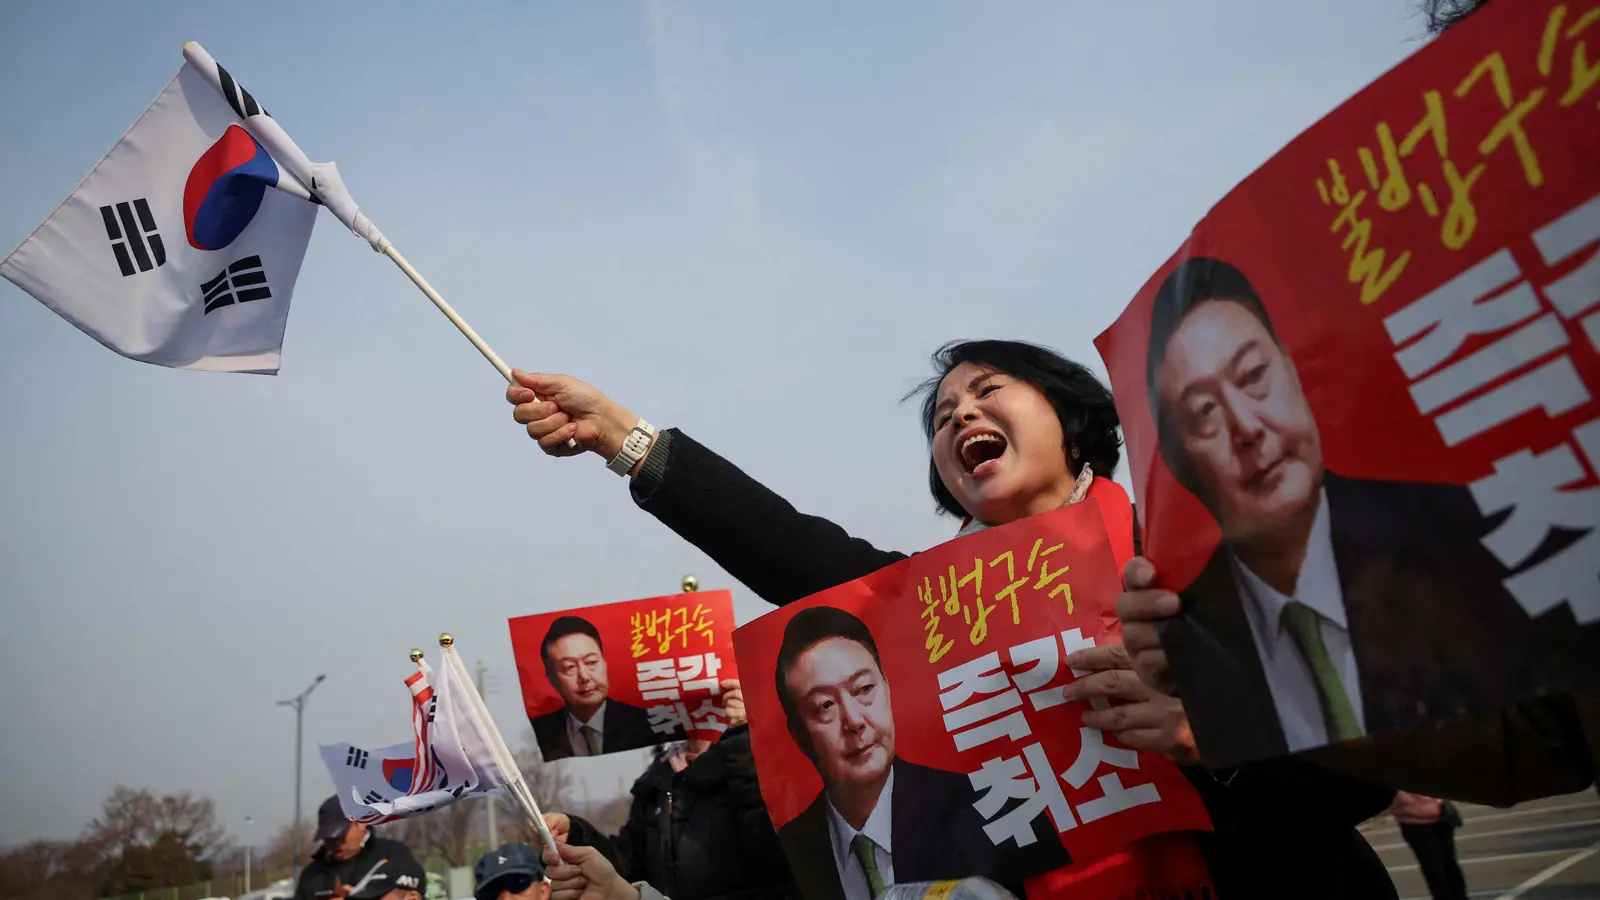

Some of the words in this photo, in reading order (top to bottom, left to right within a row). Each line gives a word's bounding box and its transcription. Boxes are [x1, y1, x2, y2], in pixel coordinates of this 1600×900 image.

[630, 604, 714, 658] 불법구속
[918, 539, 1074, 664] 불법구속
[636, 652, 721, 701] 즉각
[647, 699, 728, 735] 취소
[937, 628, 1110, 753] 즉각
[967, 727, 1162, 848] 취소
